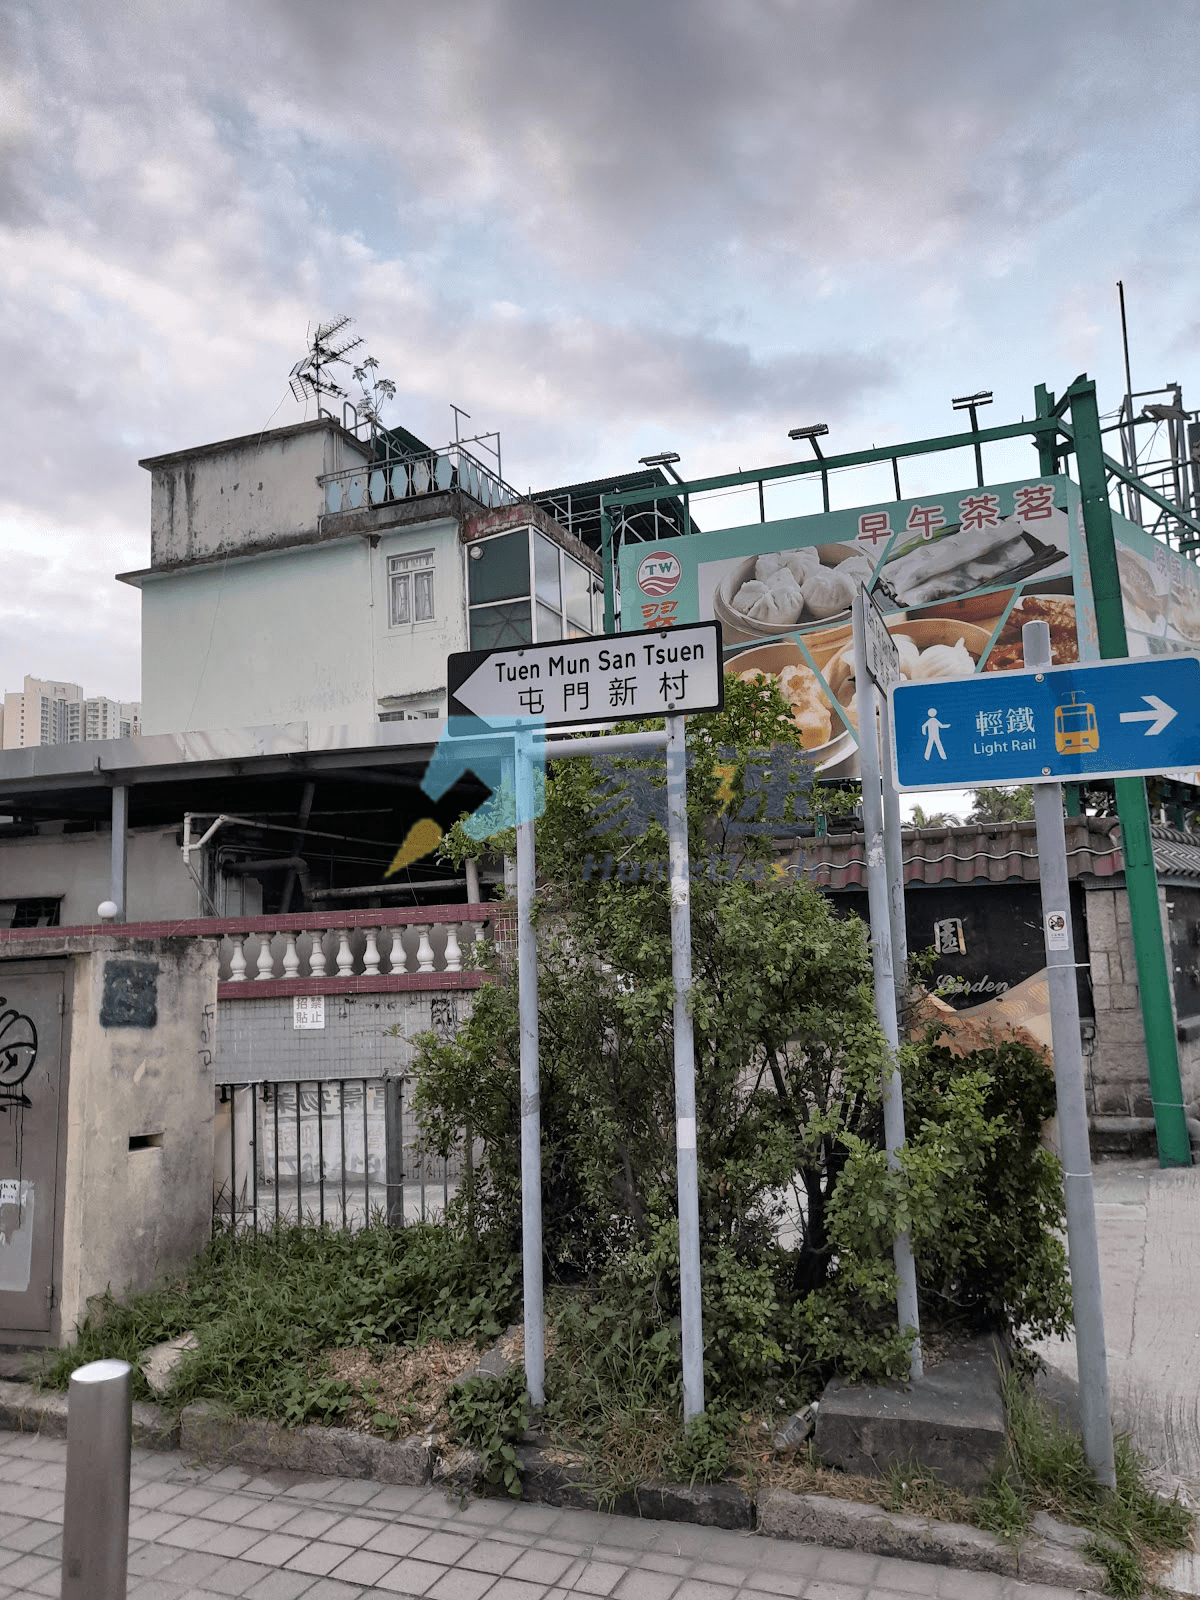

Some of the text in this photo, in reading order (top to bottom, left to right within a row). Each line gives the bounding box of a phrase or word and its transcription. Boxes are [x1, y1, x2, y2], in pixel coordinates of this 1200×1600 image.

[857, 485, 1054, 545] 早午茶茗
[645, 561, 673, 576] TW
[495, 643, 704, 682] Tuen Mun San Tsuen
[517, 669, 689, 714] 屯門新村
[975, 706, 1036, 738] 輕鐵
[973, 737, 1037, 757] Light Rail
[933, 917, 967, 956] 園
